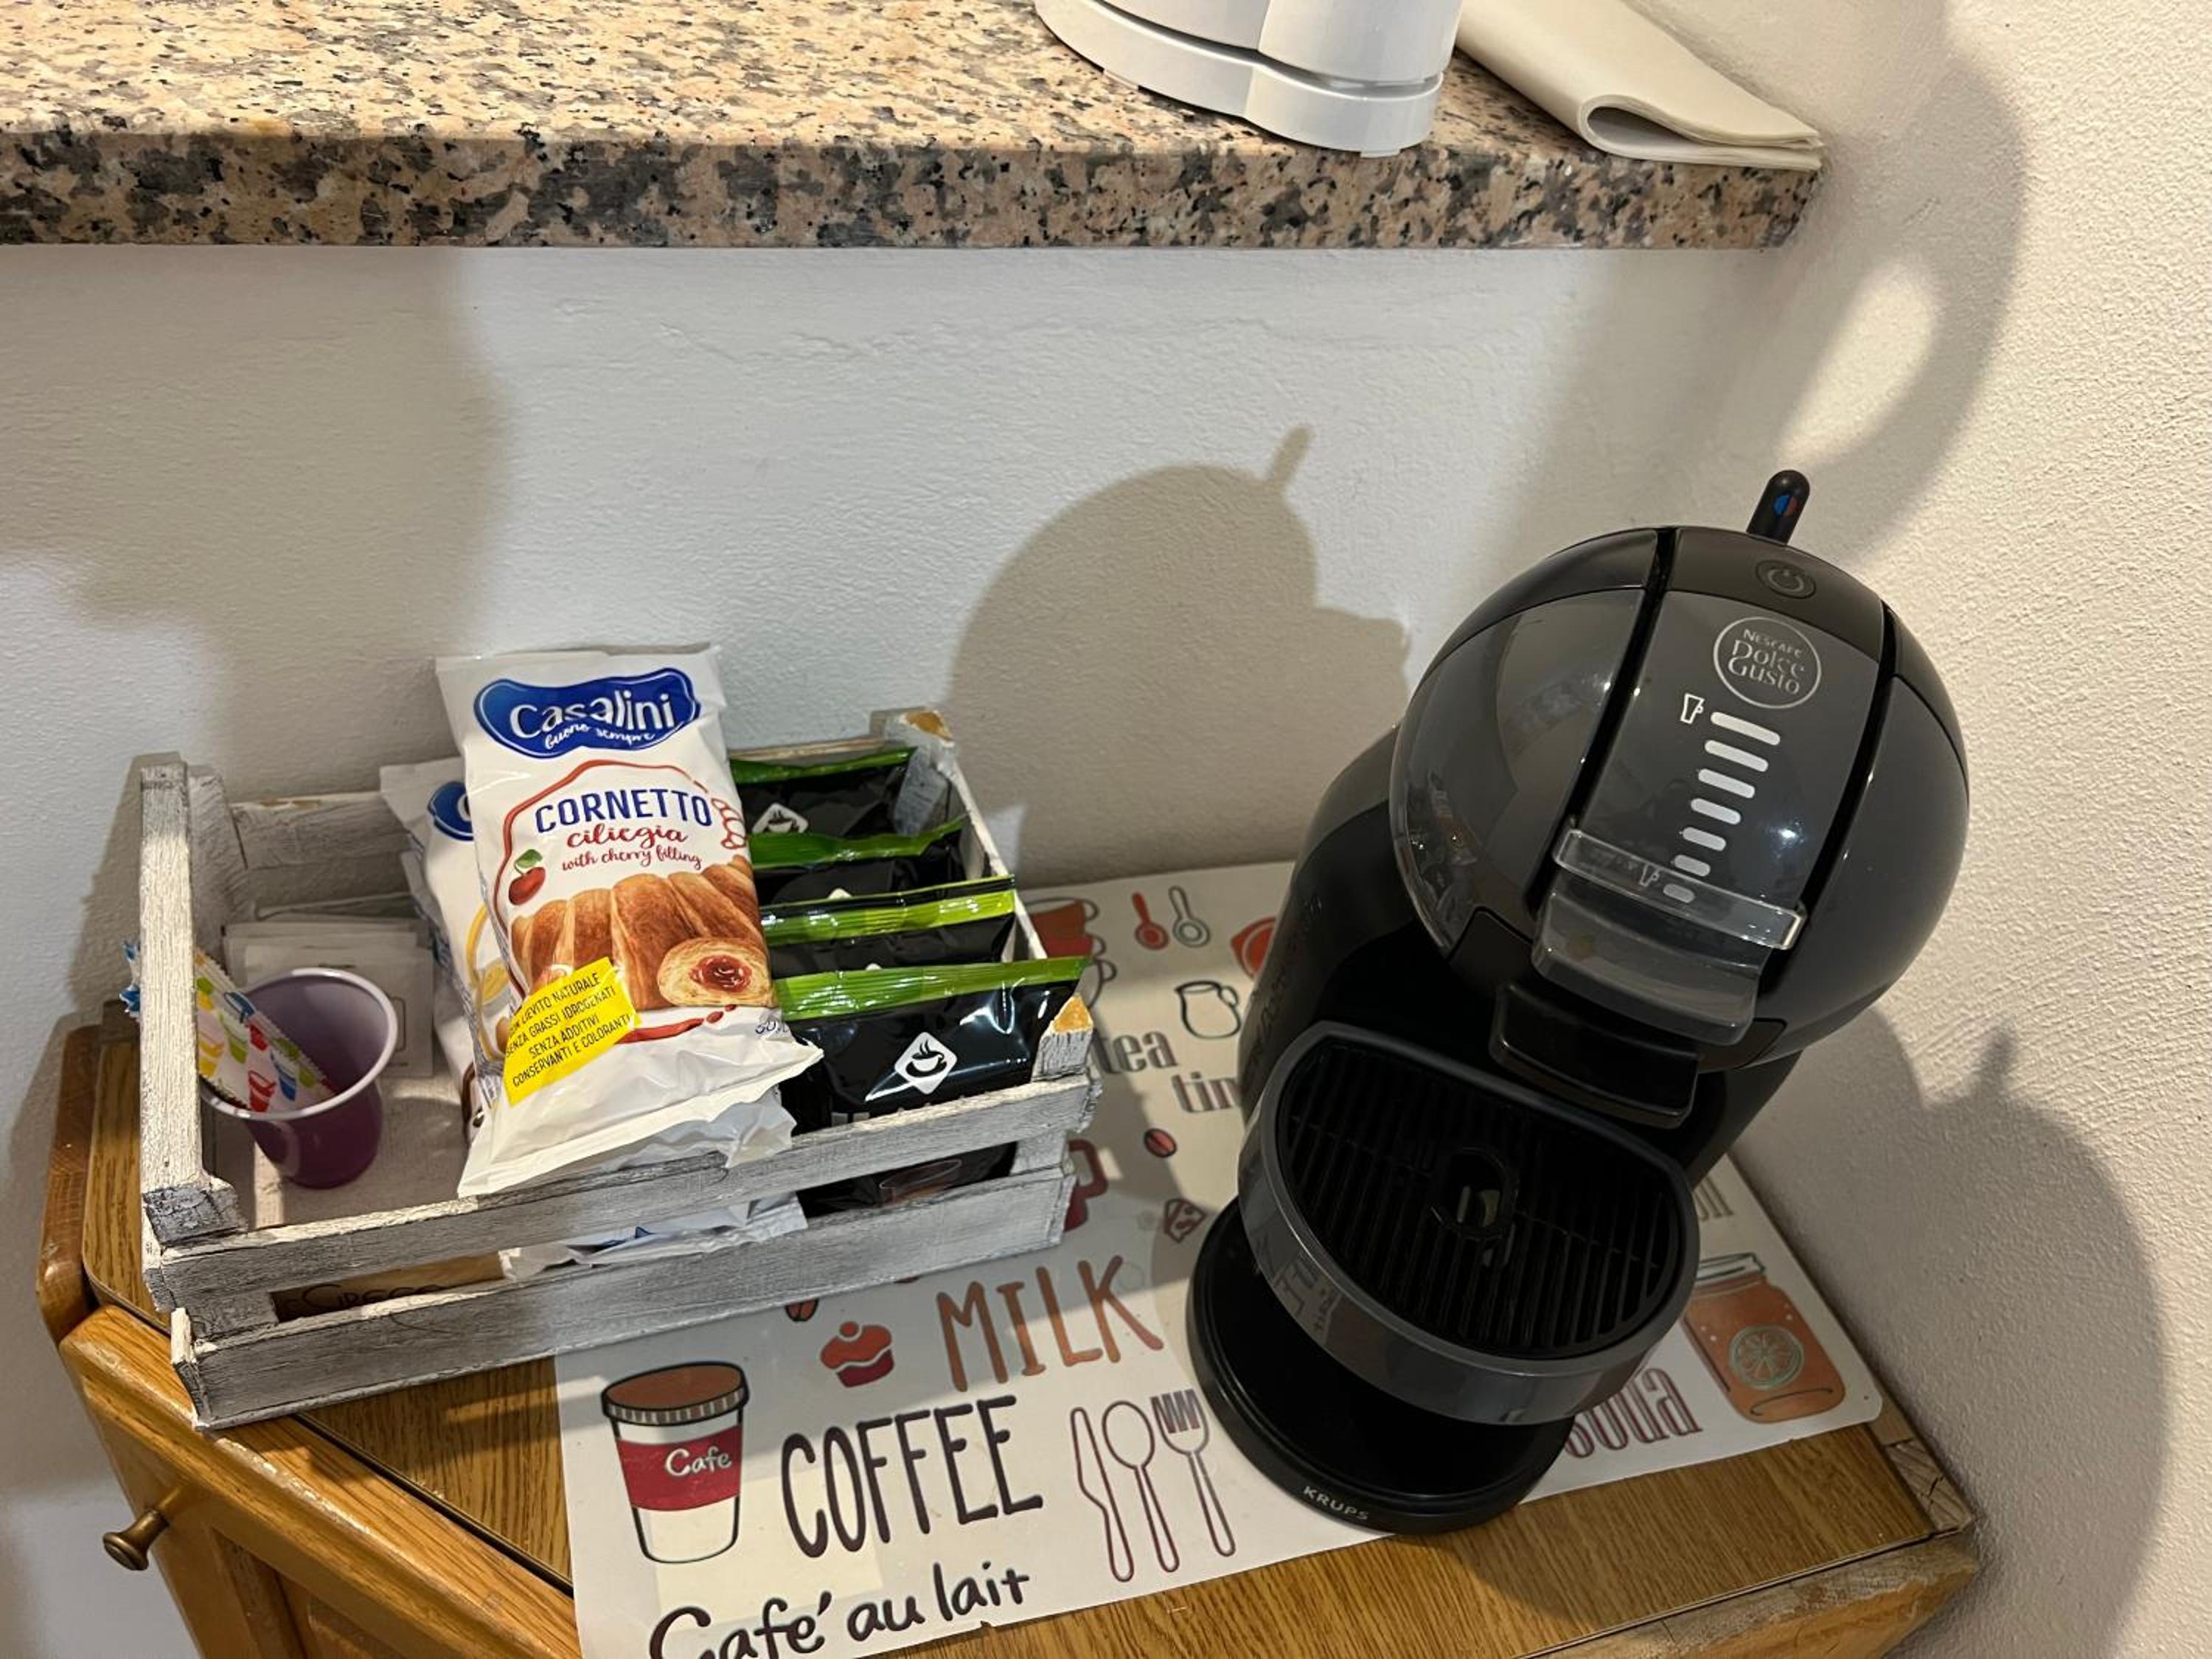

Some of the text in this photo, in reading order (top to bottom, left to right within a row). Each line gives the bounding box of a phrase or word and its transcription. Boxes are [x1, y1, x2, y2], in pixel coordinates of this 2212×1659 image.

[509, 689, 675, 740] Casalini
[534, 788, 713, 833] CORNETTO
[562, 844, 703, 872] with cherry filling
[566, 823, 689, 849] ciliegia
[529, 1014, 561, 1038] GRASSI
[563, 984, 616, 1020] IDROGENATI
[552, 973, 600, 1004] NATURALE
[512, 1014, 631, 1087] CONSERVANTI E COLORANTI
[528, 1013, 600, 1059] SENZA ADDITIVI
[936, 1255, 1164, 1392] MILK
[665, 1446, 732, 1477] Cafe
[781, 1395, 1043, 1558] COFFEE
[1304, 1486, 1369, 1520] KRUPS
[847, 1596, 926, 1642] au
[933, 1561, 1030, 1621] lait
